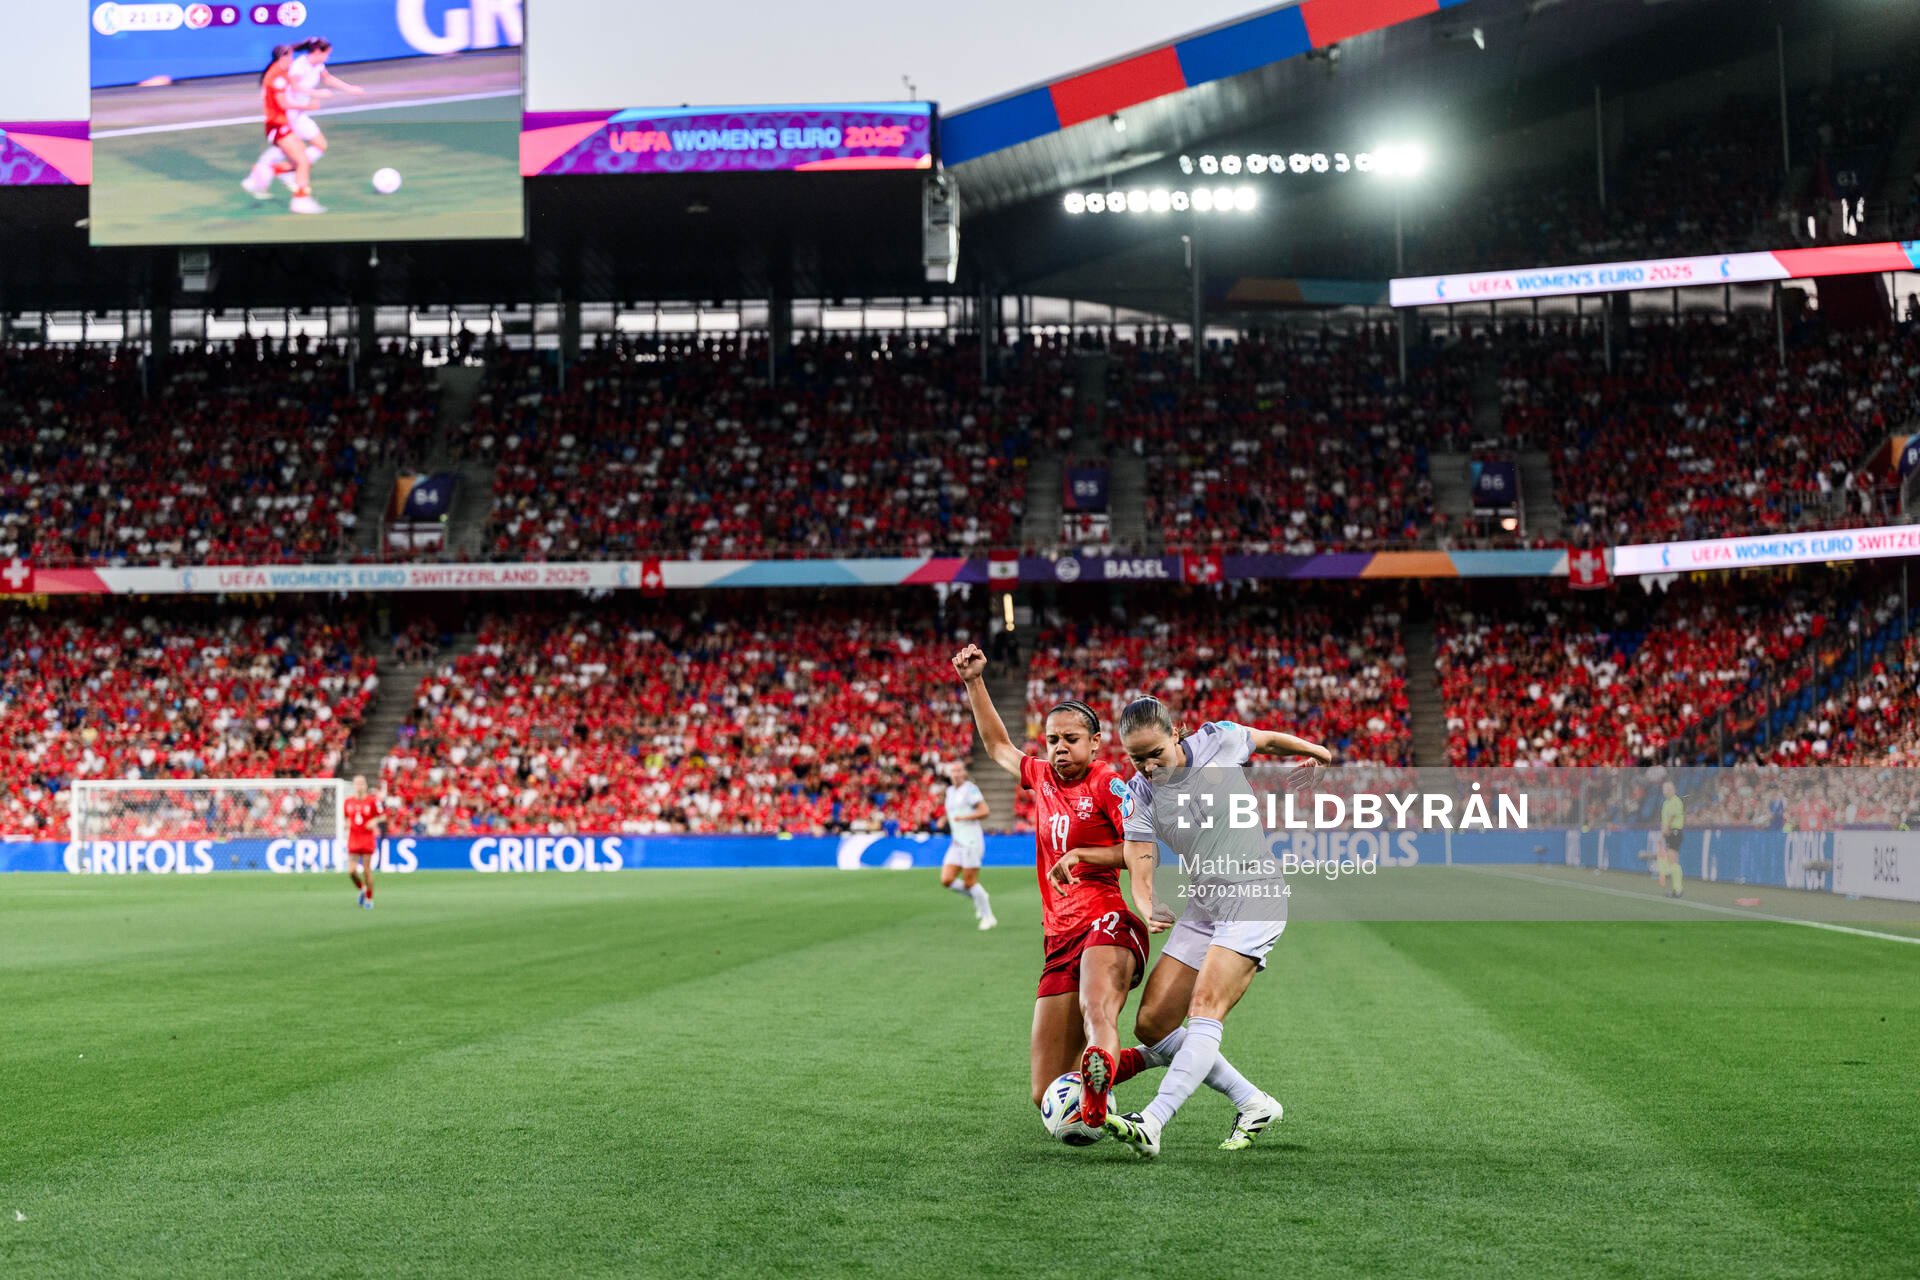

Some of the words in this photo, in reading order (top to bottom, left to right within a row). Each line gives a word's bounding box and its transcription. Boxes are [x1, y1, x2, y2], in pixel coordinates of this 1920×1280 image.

[609, 130, 672, 153] UEFA
[671, 127, 778, 151] WOMEN'S
[779, 126, 841, 149] EURO
[843, 124, 909, 148] 2025
[1468, 278, 1513, 294] UEFA
[1516, 270, 1594, 290] WOMEN'S
[1599, 267, 1645, 284] EURO
[1649, 262, 1693, 281] 2025
[1692, 547, 1732, 564] UEFA
[1734, 540, 1807, 560] WOMEN'S
[1811, 535, 1854, 556] EURO
[1857, 530, 1920, 552] SWITZE
[219, 570, 266, 587] UEFA
[270, 569, 353, 587] WOMEN'S
[357, 568, 407, 586] EURO
[410, 567, 540, 585] SWITZERLAND
[544, 567, 591, 584] 2025
[1103, 559, 1169, 579] BASEL
[1049, 812, 1071, 853] 19
[1263, 831, 1420, 867] GRIFOLS
[63, 839, 215, 875] GRIFOLS
[265, 838, 418, 873] GRIFLS
[469, 836, 624, 873] GRIFOLS
[1873, 845, 1901, 884] BASEL
